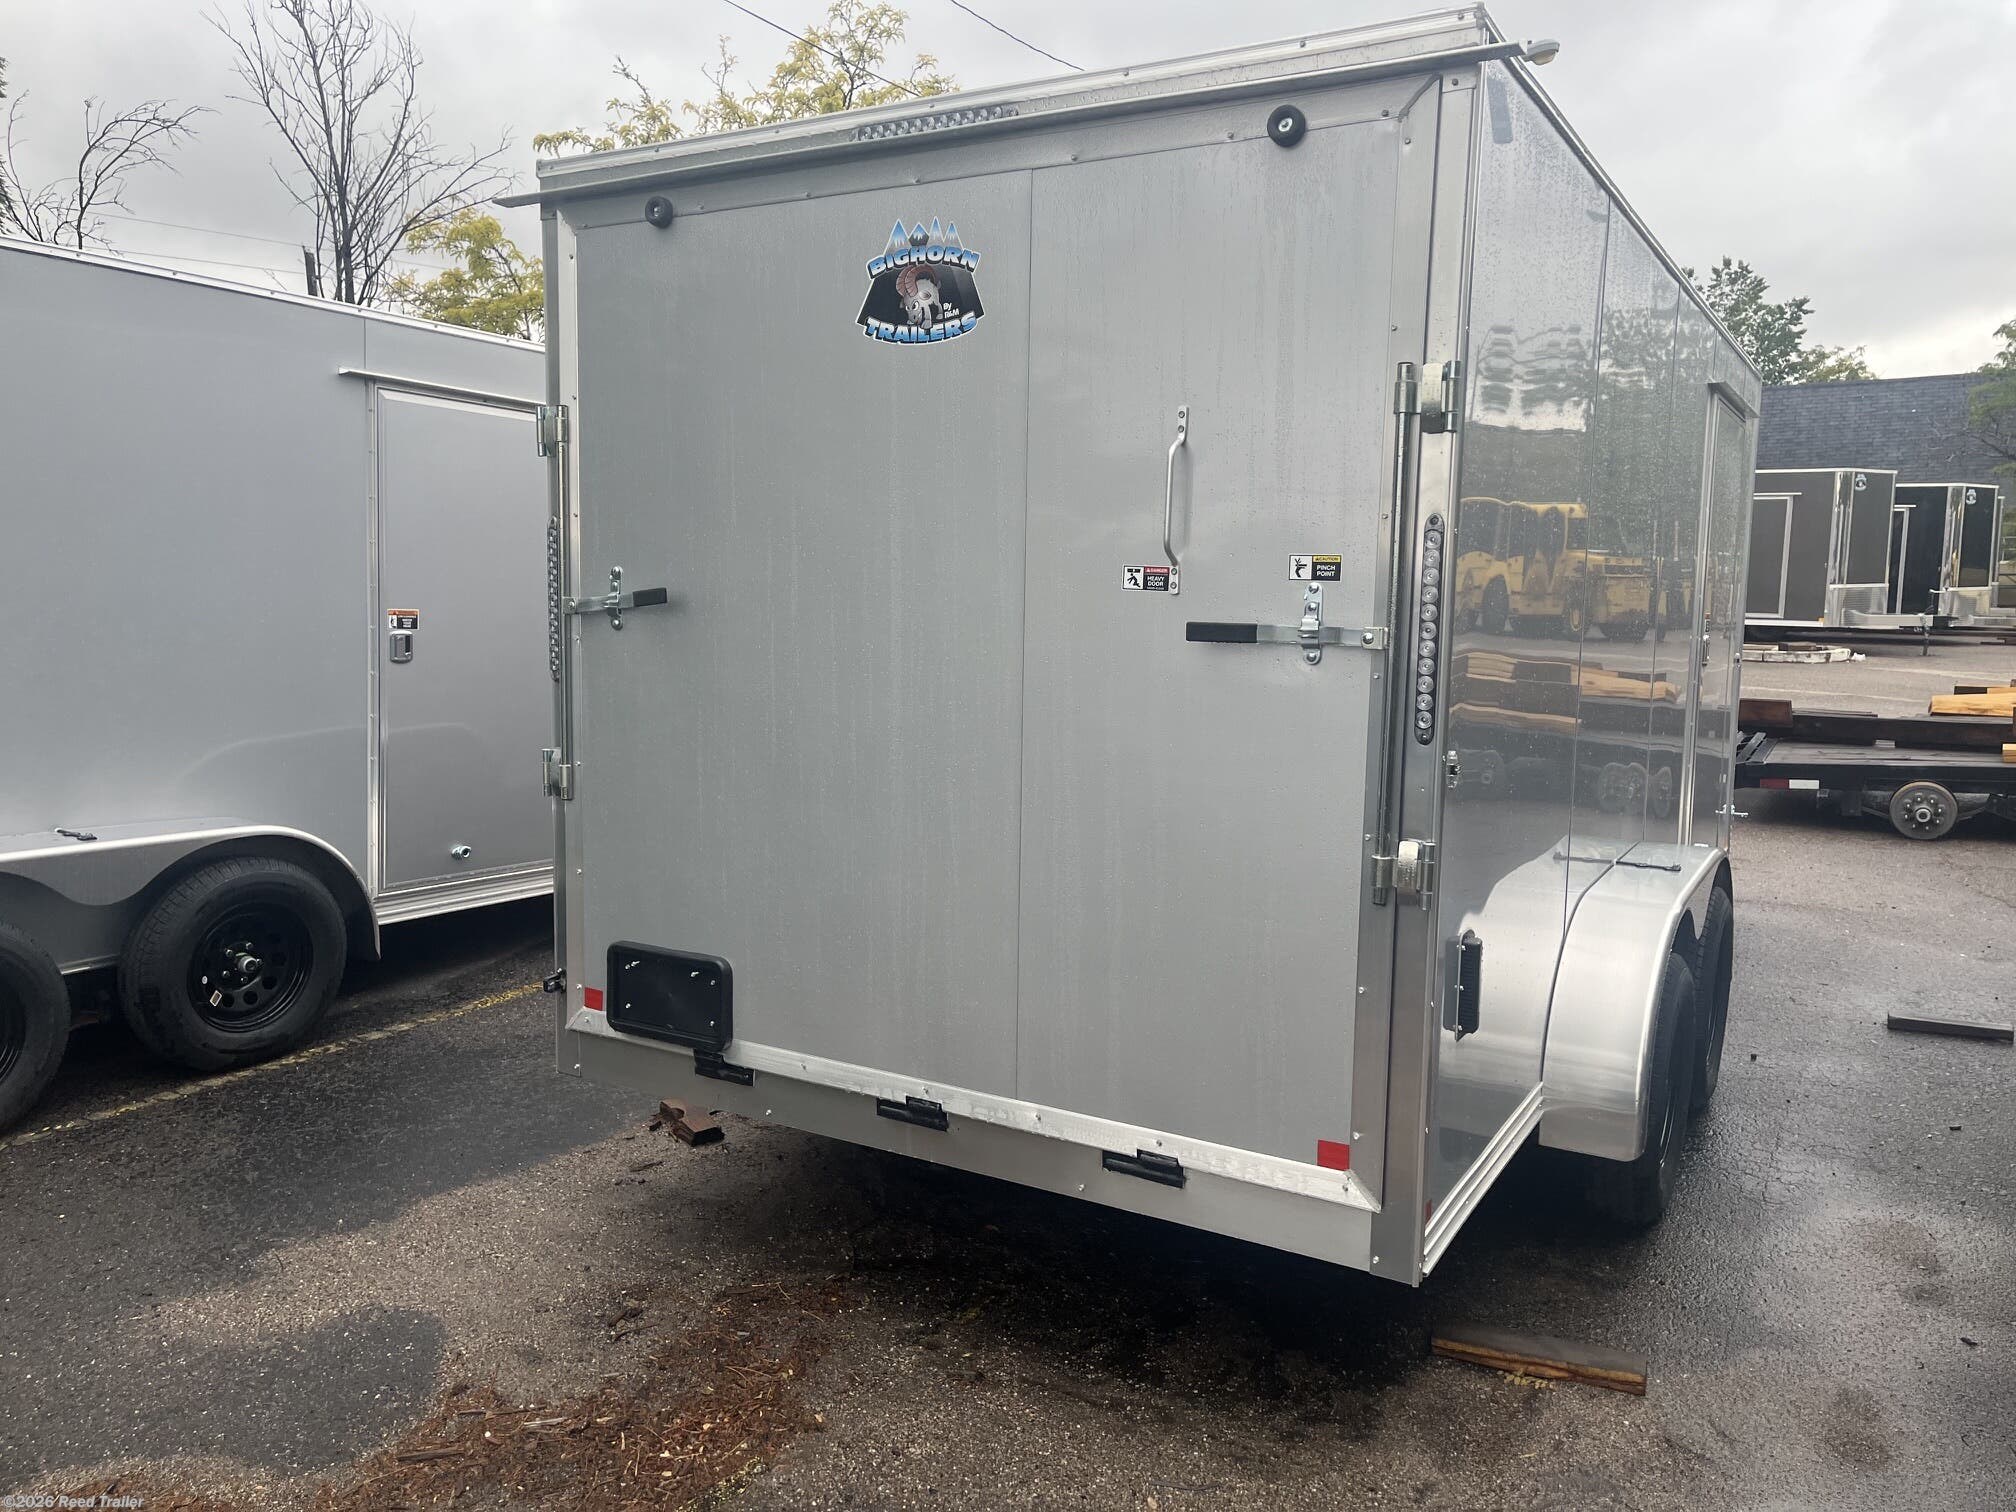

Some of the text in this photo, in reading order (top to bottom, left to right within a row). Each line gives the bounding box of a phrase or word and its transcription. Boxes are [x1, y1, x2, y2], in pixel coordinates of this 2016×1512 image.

[868, 245, 980, 279] BIGHORN
[943, 302, 952, 311] By
[865, 311, 978, 343] TRAILERS
